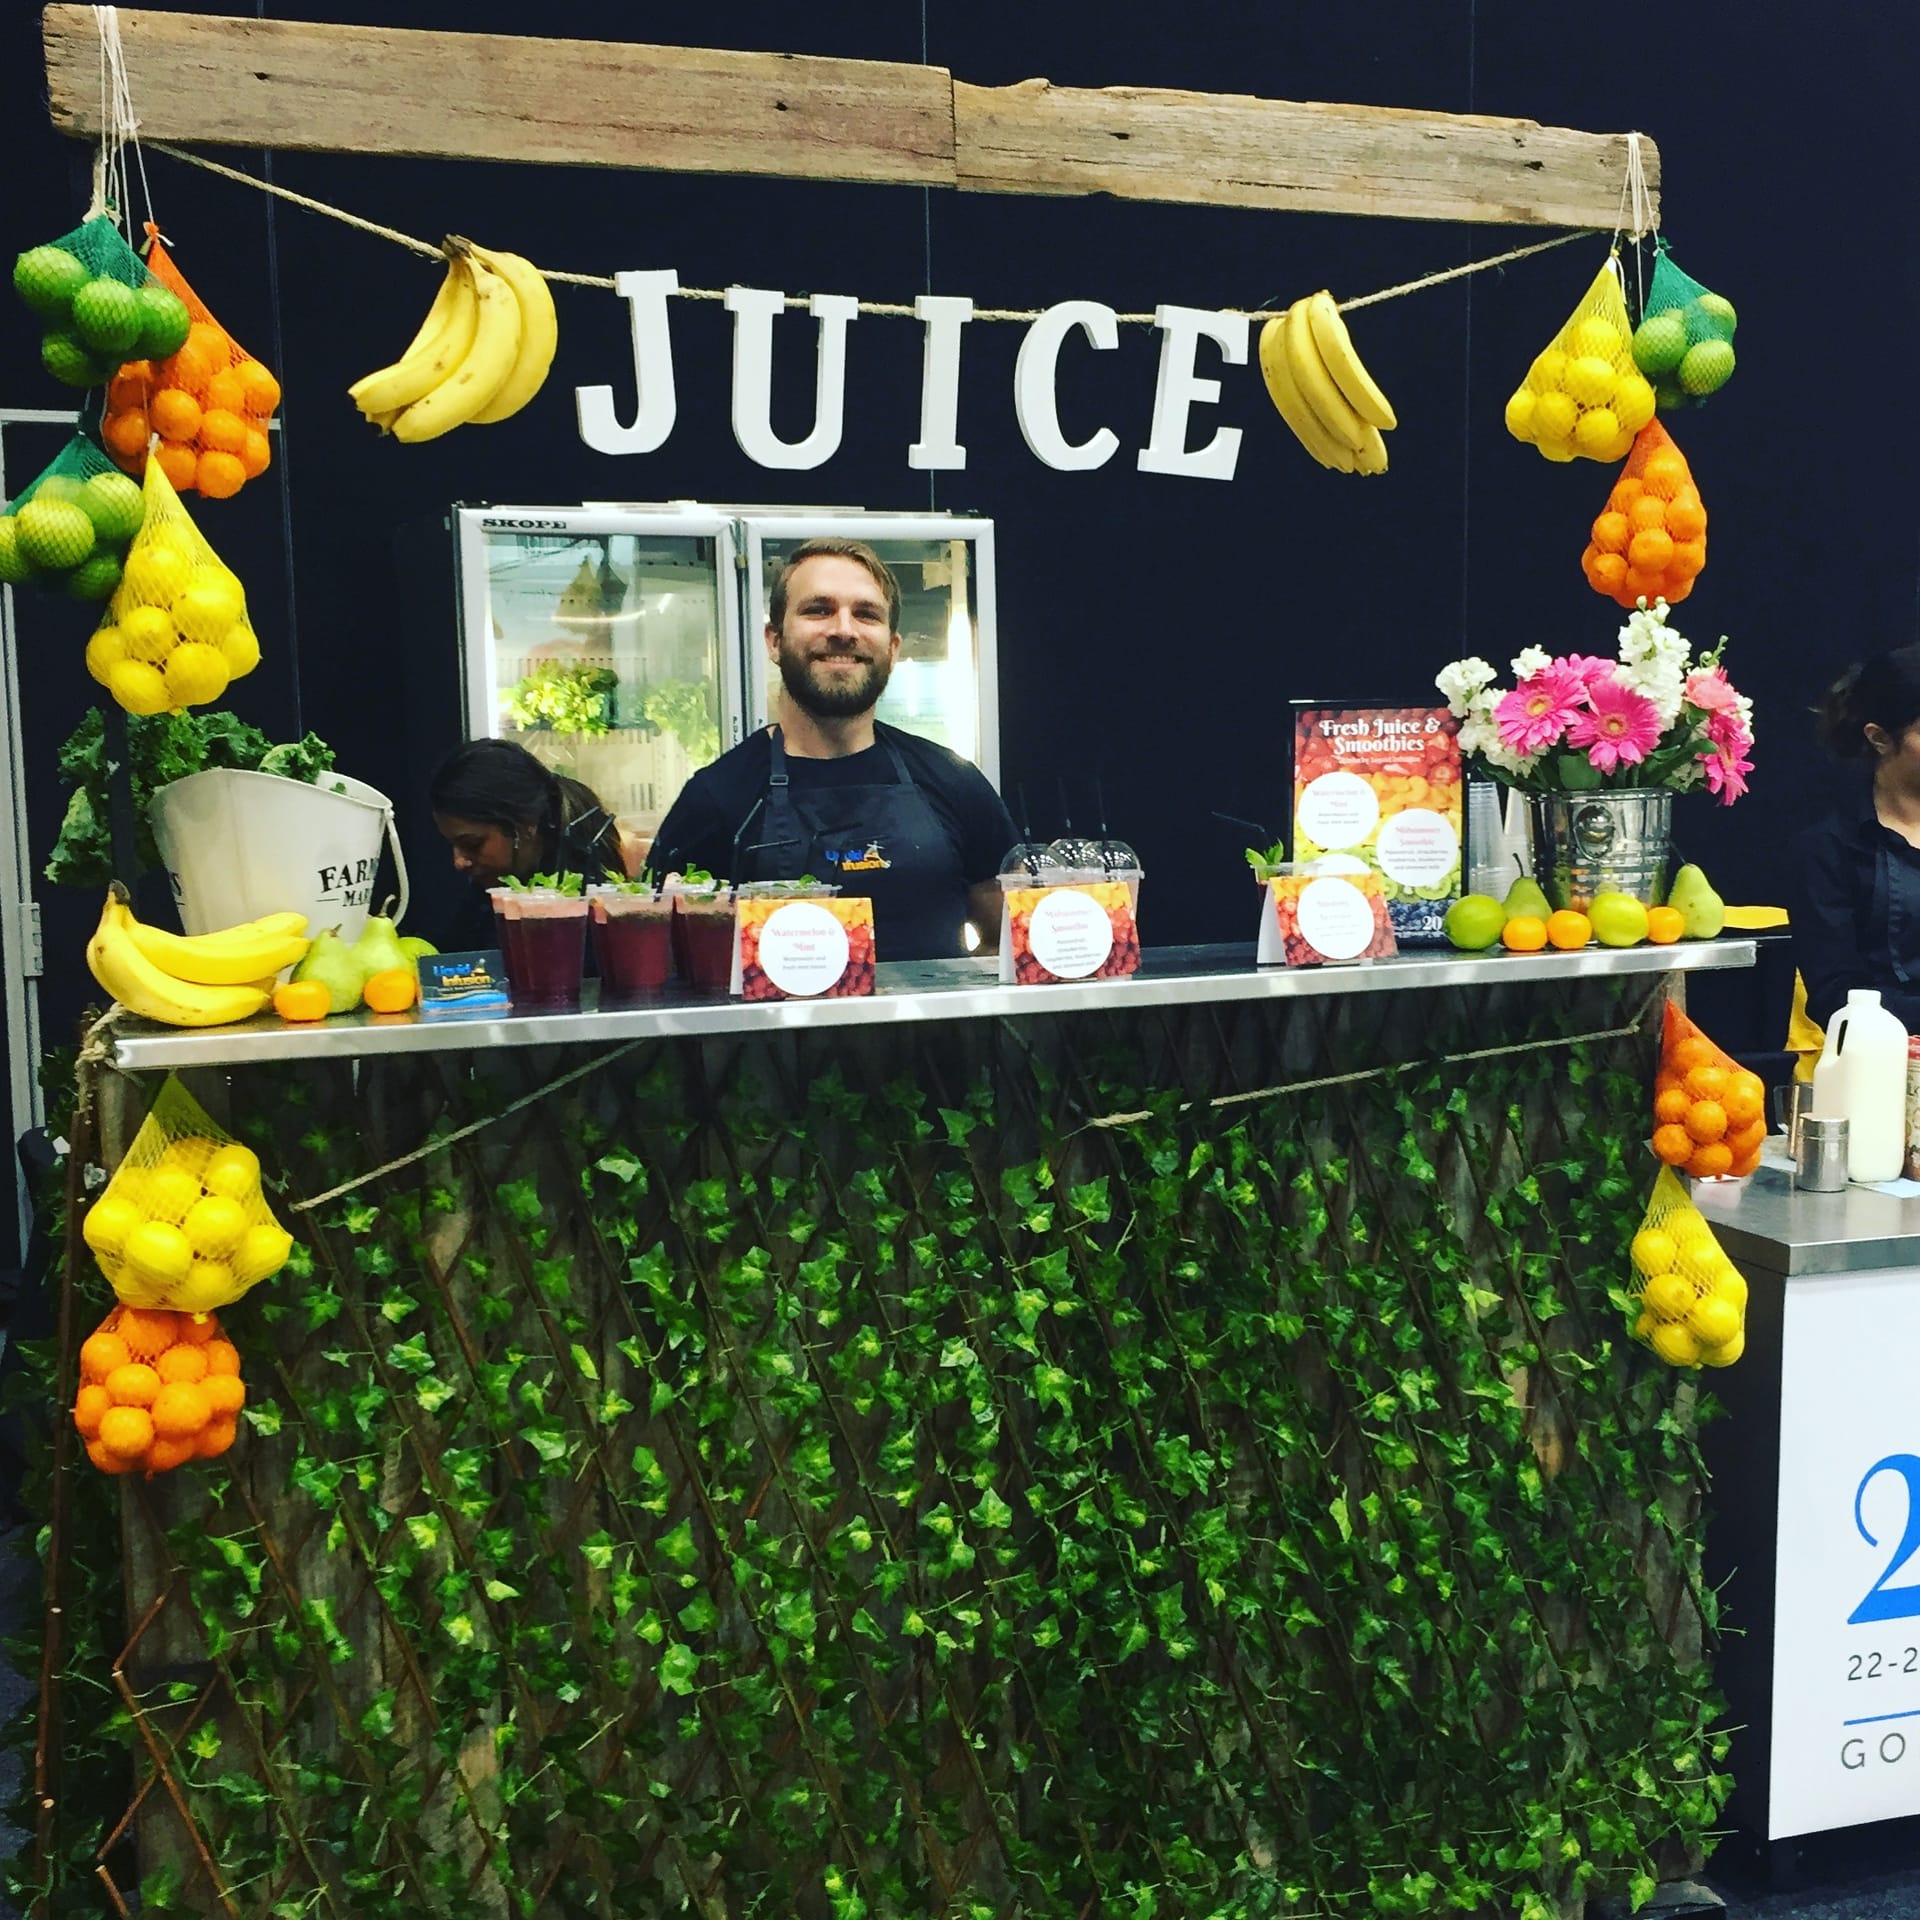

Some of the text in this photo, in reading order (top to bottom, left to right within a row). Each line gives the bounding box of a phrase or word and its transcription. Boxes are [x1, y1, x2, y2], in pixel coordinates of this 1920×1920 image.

[576, 268, 1249, 481] JUICE
[482, 518, 567, 530] SKOPE
[1318, 716, 1441, 738] Fresh Juice &
[1333, 735, 1425, 755] Smoothies
